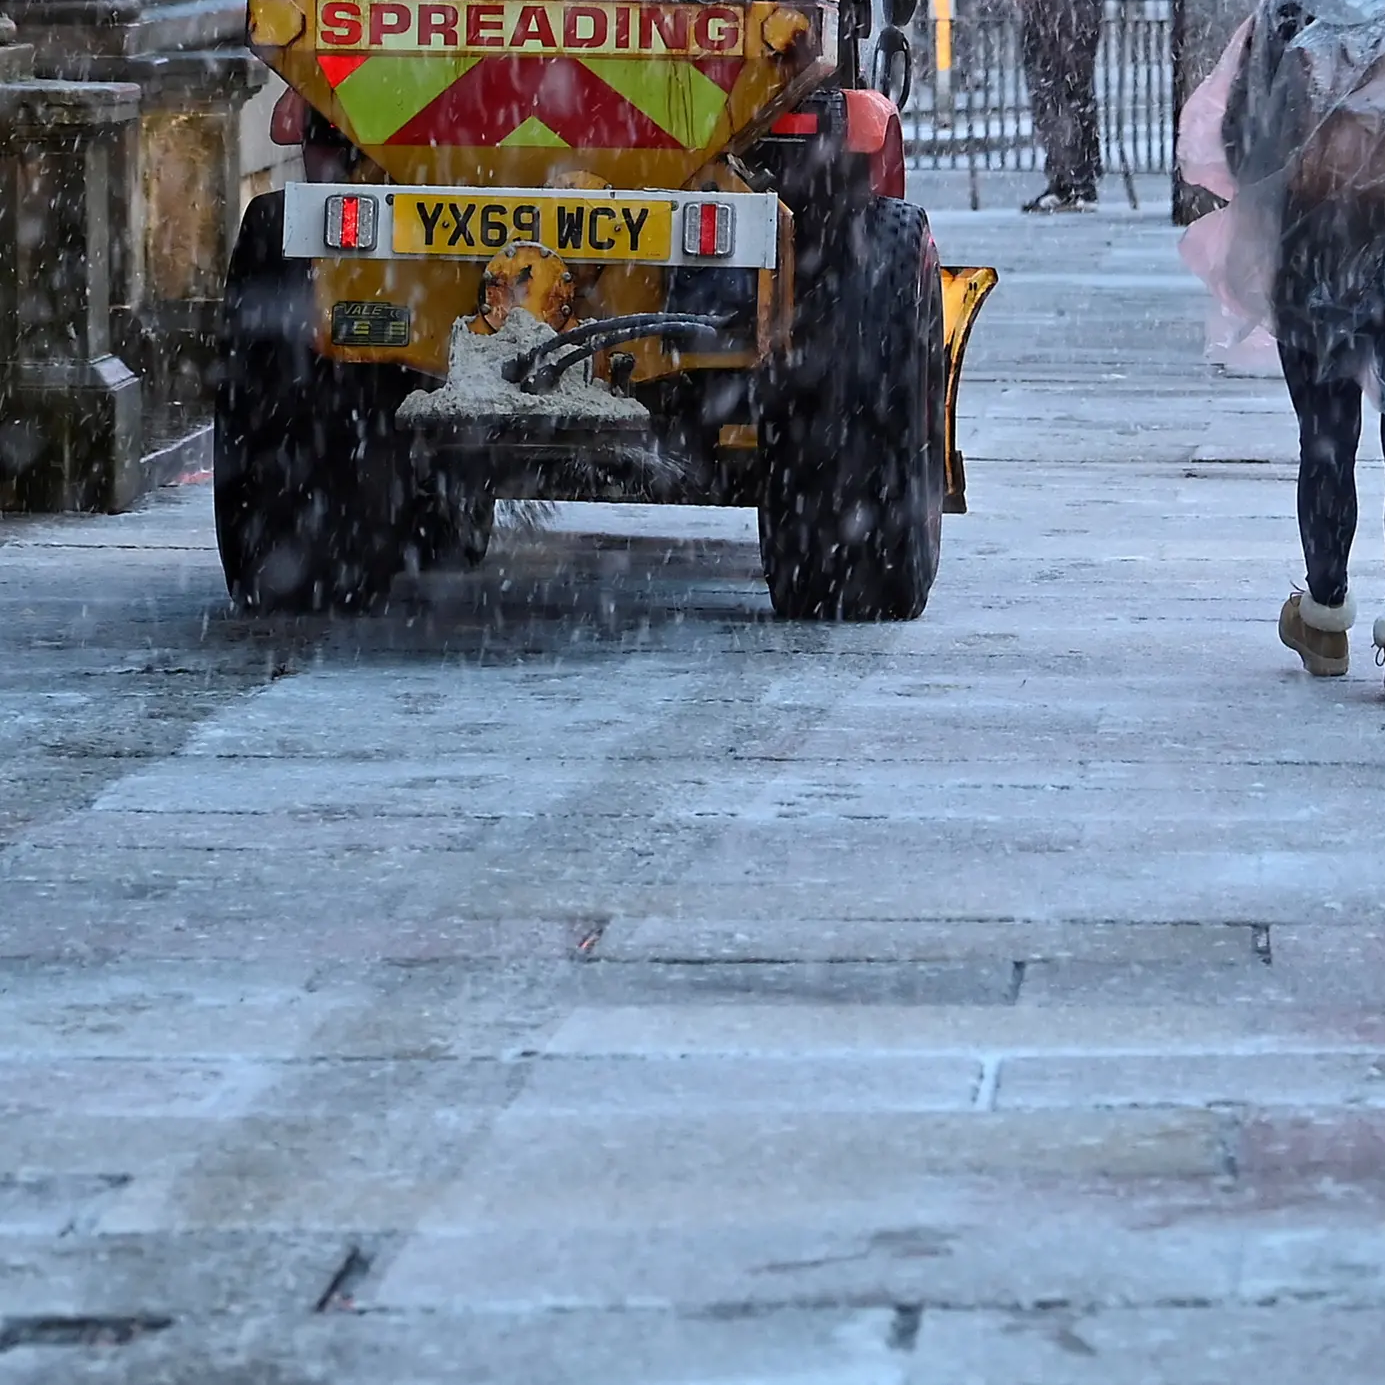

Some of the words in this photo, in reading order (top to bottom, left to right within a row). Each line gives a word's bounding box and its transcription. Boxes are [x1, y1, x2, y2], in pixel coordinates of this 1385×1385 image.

[320, 1, 740, 51] SPREADING
[416, 202, 541, 247] YX69
[557, 205, 649, 251] WCY
[343, 303, 382, 316] VALE
